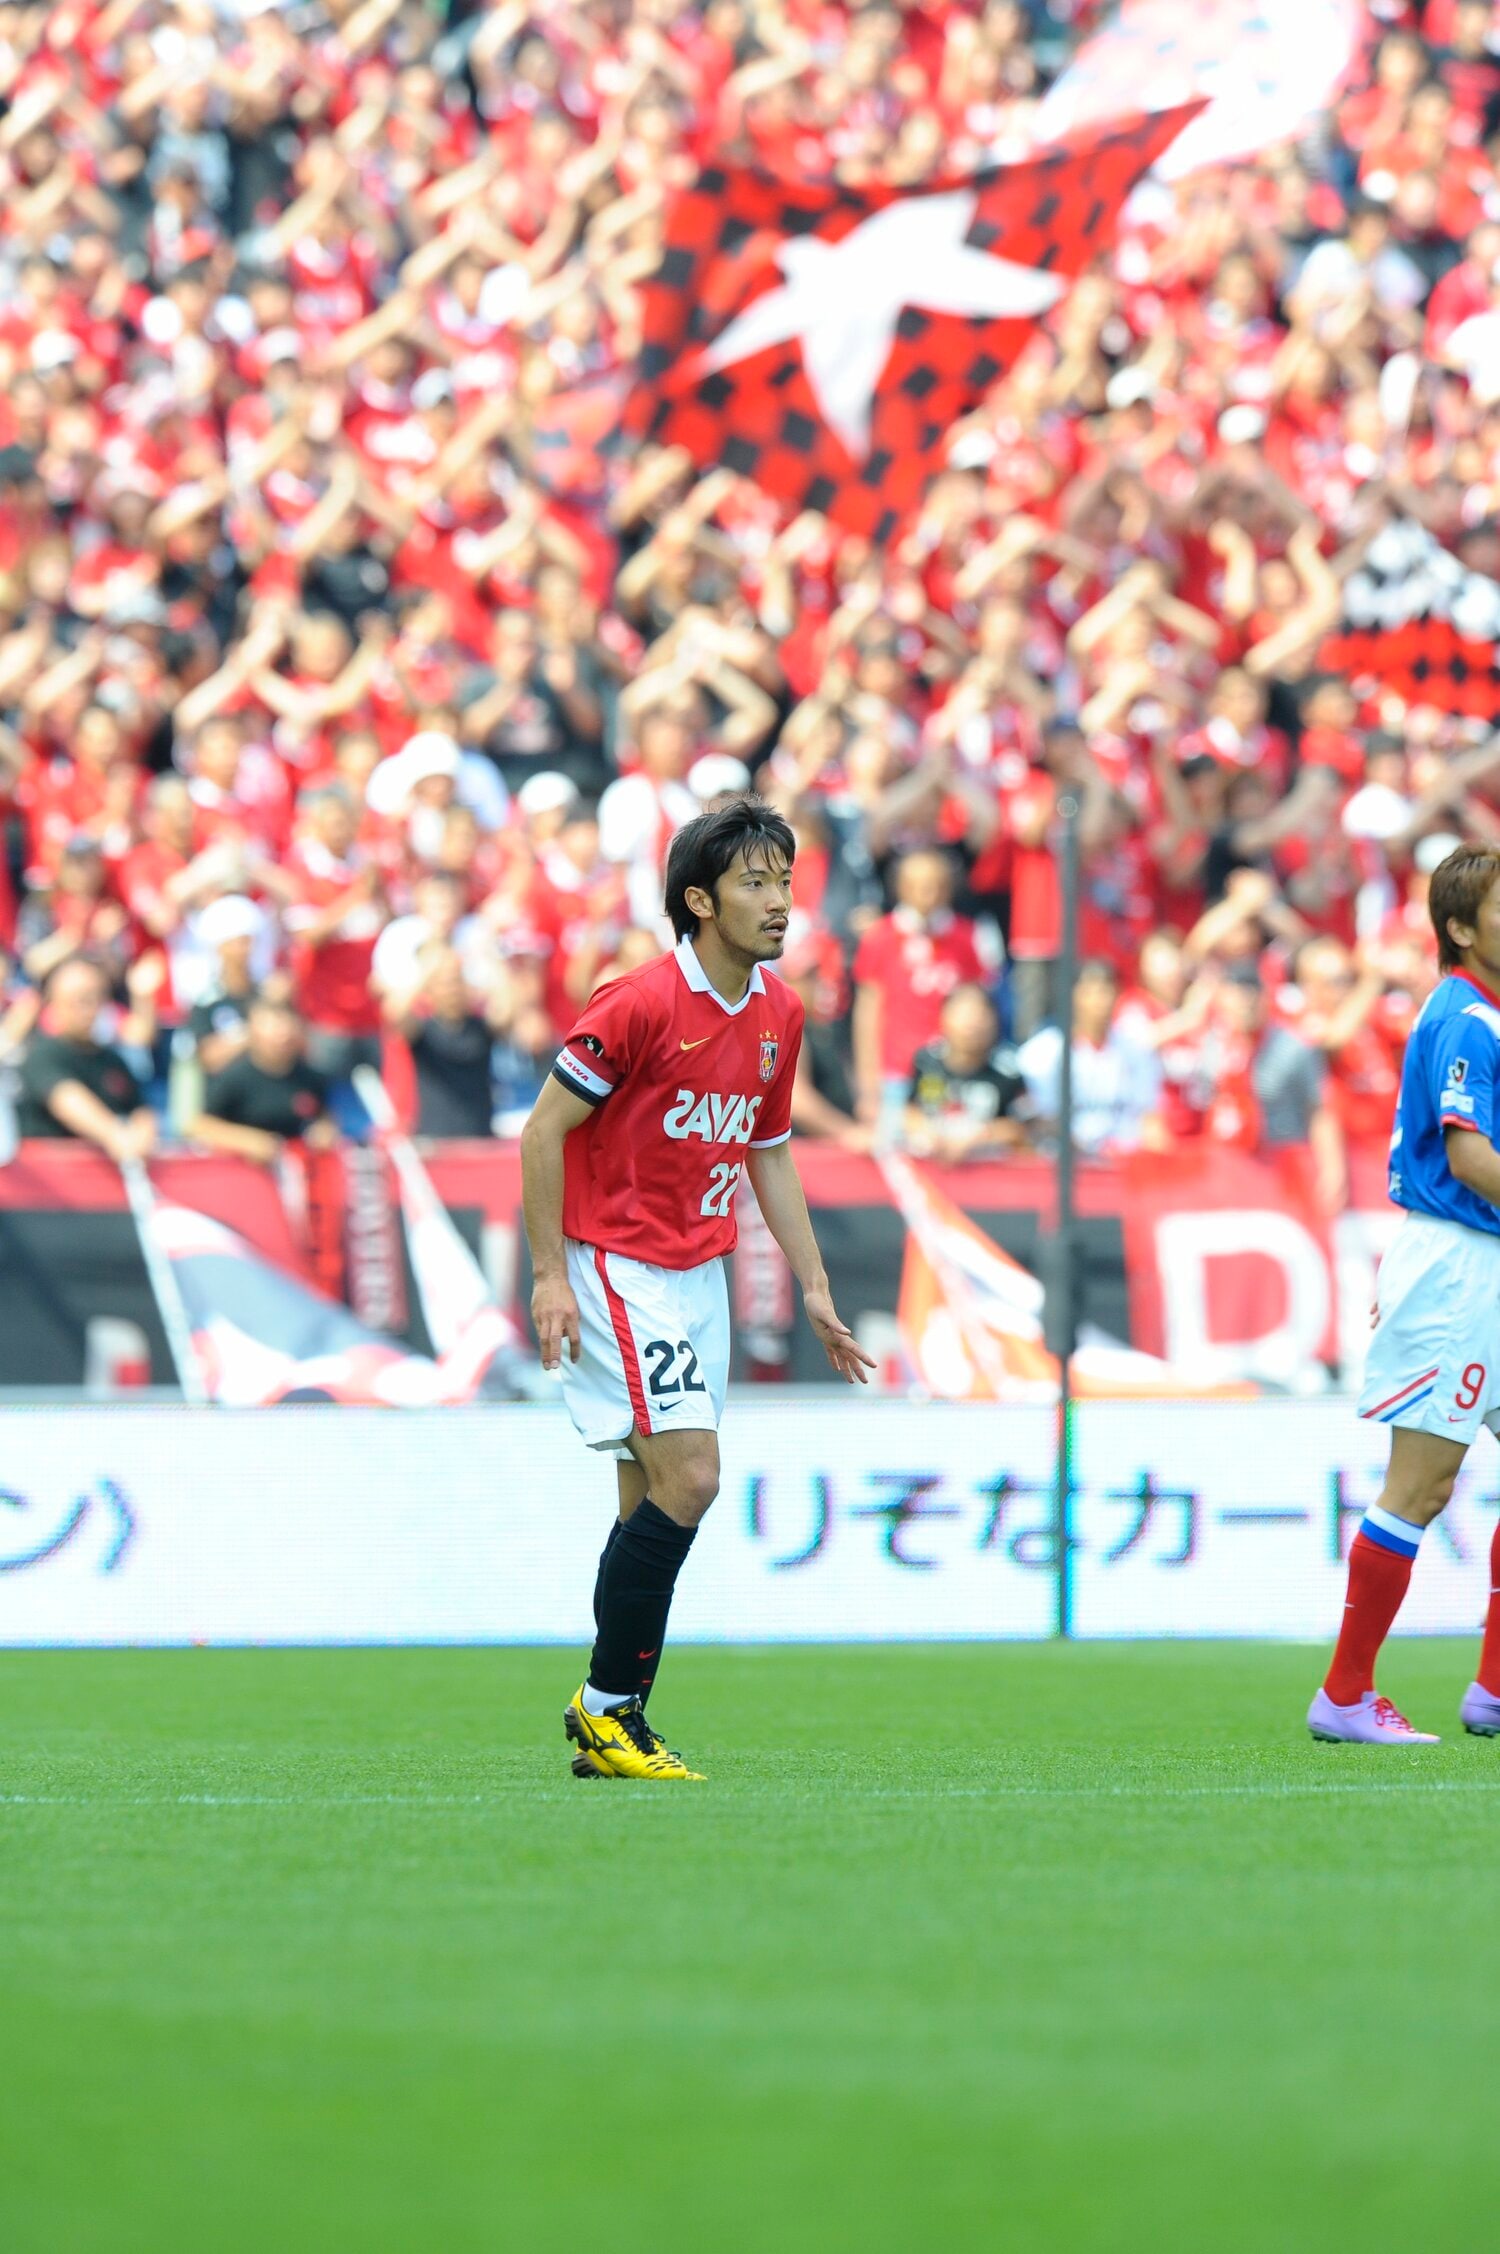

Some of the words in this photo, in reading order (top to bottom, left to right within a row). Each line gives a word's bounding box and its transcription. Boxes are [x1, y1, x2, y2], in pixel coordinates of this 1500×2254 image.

[663, 1089, 763, 1144] SAVAS
[700, 1162, 741, 1217] 22
[644, 1339, 706, 1396] 22
[1456, 1363, 1485, 1410] 9
